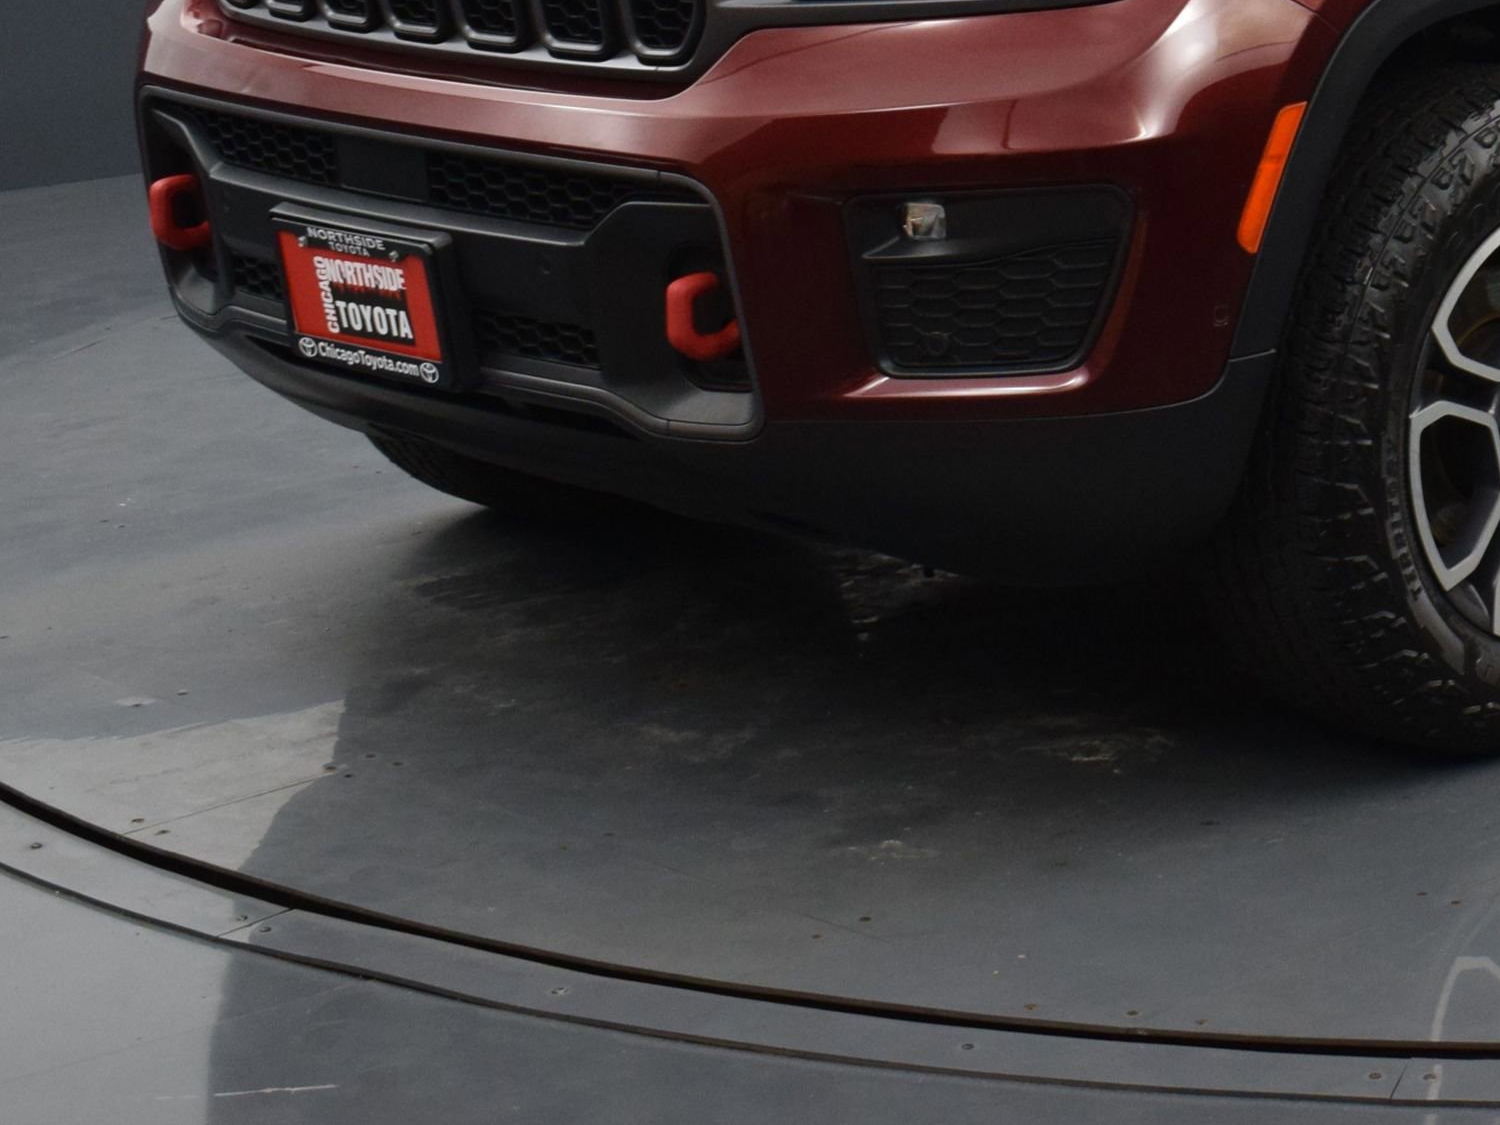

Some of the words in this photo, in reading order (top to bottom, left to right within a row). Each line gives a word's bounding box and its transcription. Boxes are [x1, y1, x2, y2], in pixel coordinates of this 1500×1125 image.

[306, 226, 386, 251] NORTHSIDE
[329, 241, 371, 257] TOYOTA
[324, 258, 407, 291] NORTHSIDE
[313, 255, 341, 334] CHICAGO
[336, 300, 414, 339] TOYOTA
[318, 341, 420, 377] ChicagoToyota.com
